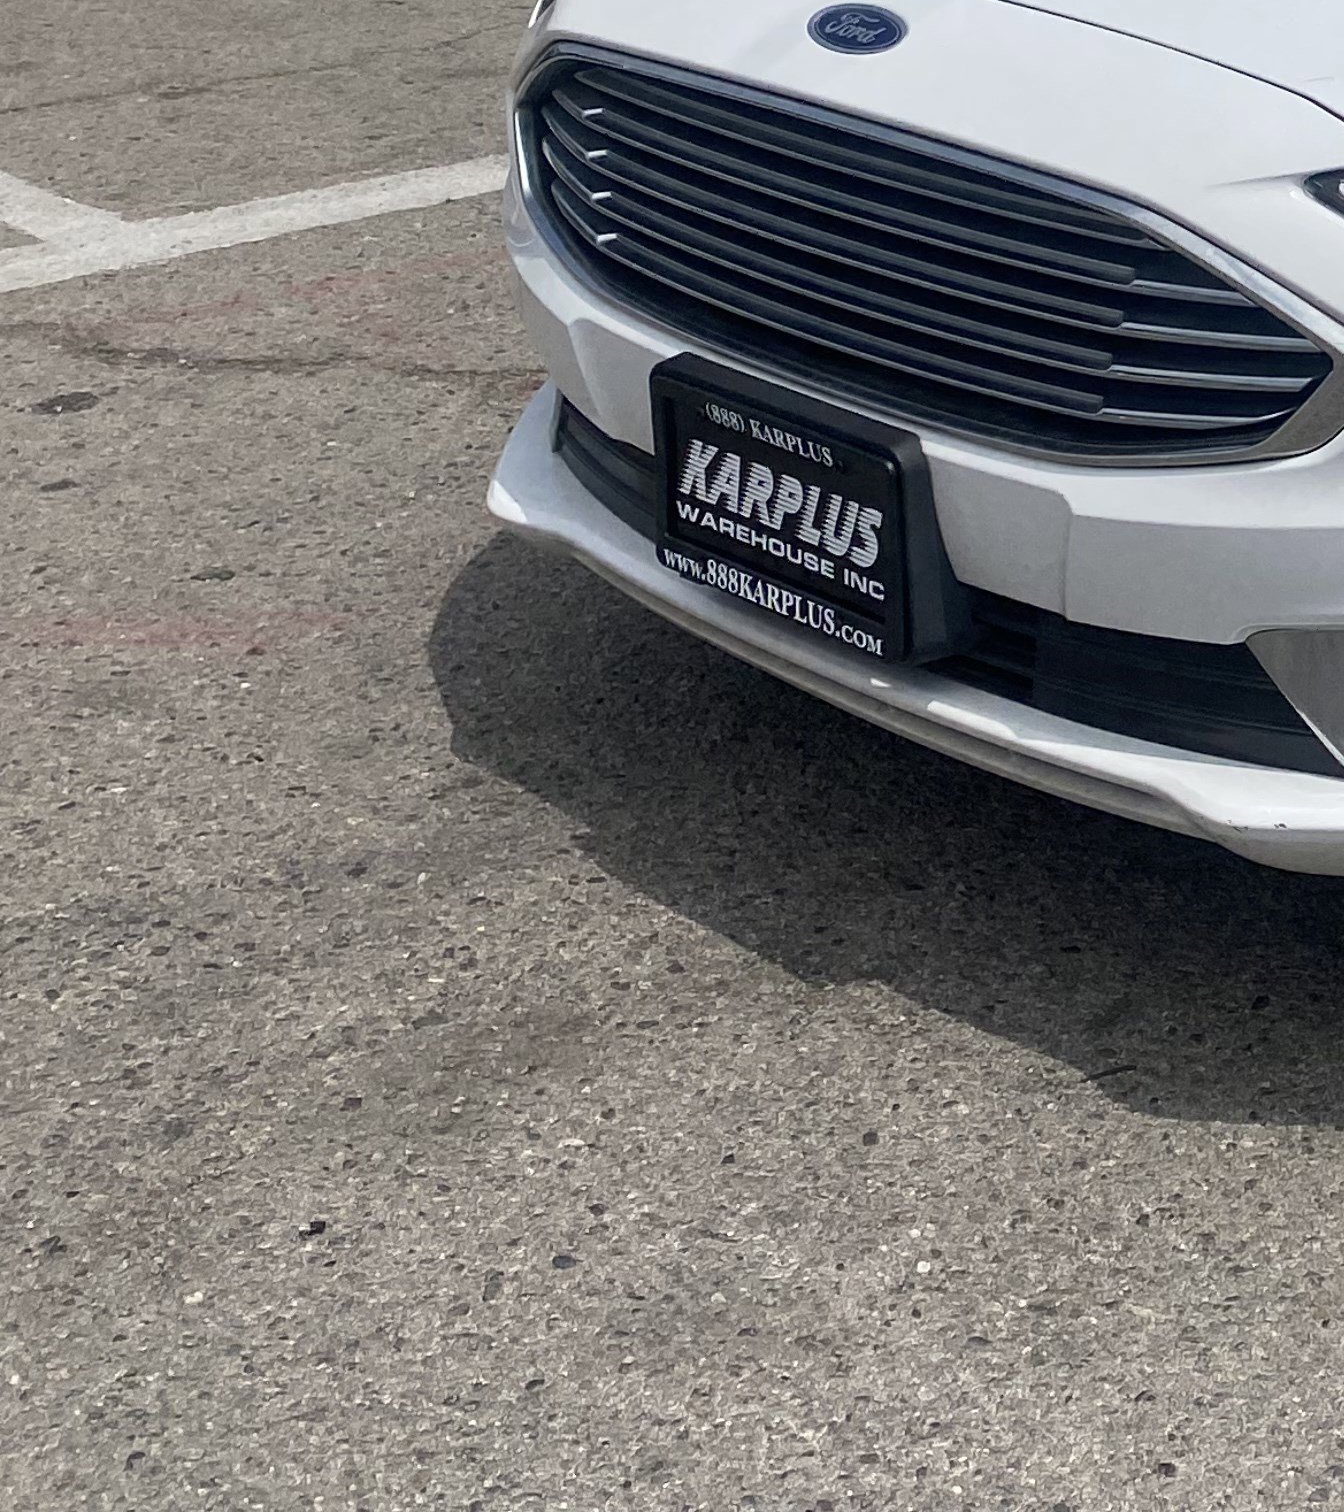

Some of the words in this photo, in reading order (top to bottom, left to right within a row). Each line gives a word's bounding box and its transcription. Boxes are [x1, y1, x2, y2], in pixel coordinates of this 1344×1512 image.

[825, 11, 887, 44] Ford
[704, 400, 746, 434] (888)
[748, 417, 833, 469] KARPLUS
[677, 438, 883, 569] KARPLUS
[676, 500, 835, 579] WAREHOUSE
[843, 567, 886, 602] INC
